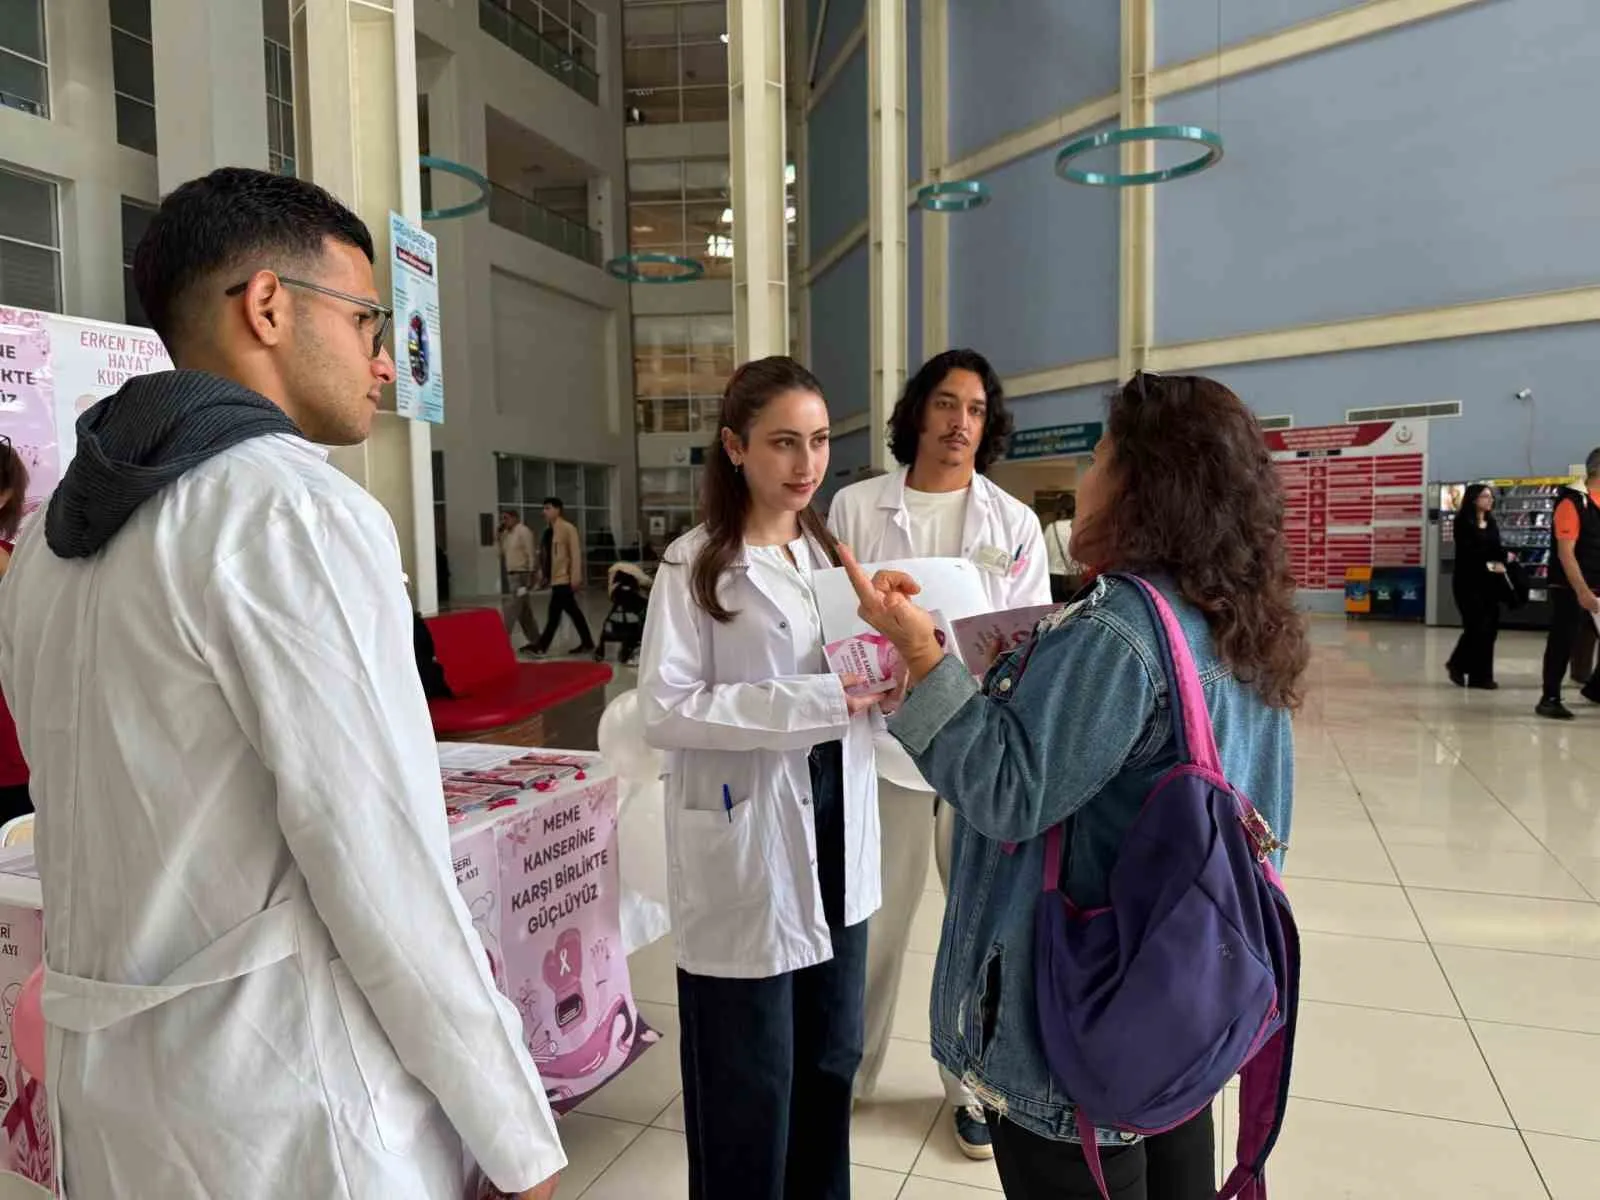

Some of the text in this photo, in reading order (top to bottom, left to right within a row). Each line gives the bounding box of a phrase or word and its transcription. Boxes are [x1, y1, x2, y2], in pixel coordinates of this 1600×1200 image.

[80, 331, 126, 352] ERKEN
[108, 353, 152, 372] HAYAT
[543, 804, 581, 835] MEME
[523, 826, 595, 873] KANSERİNE
[511, 849, 608, 913] KARŞI BİRLİKTE
[528, 883, 598, 934] GÜÇLÜYÜZ
